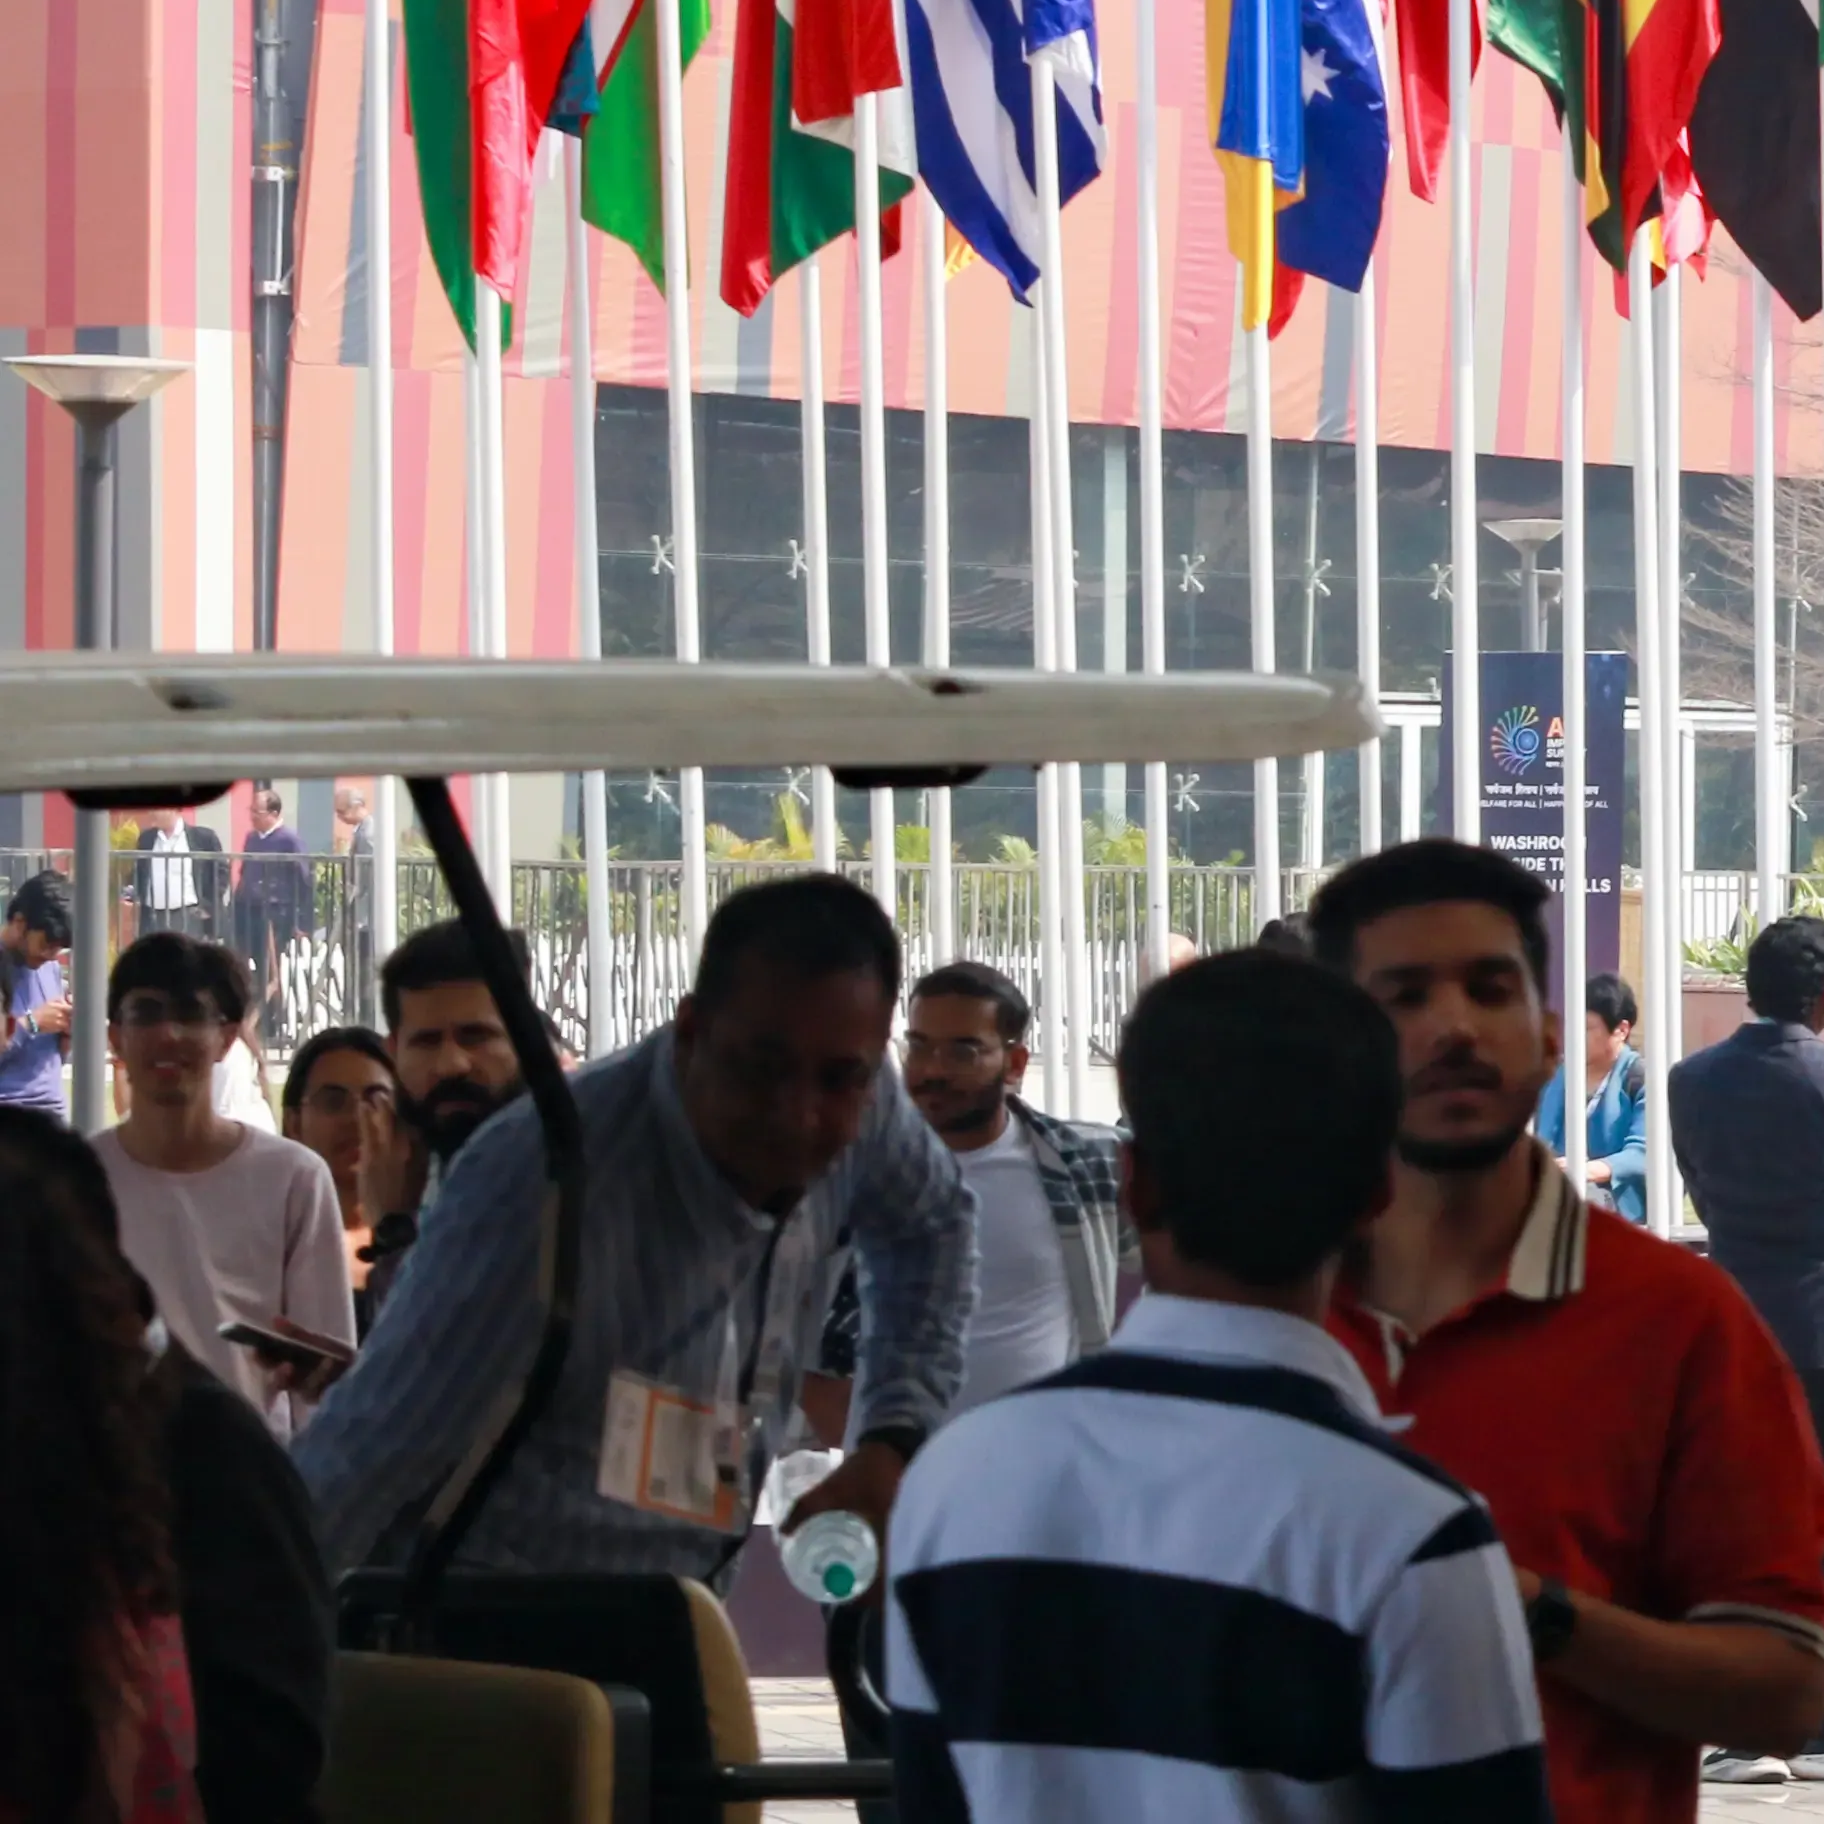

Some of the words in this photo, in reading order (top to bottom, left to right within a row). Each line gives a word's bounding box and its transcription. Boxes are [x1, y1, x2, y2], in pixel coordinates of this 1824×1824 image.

[1546, 716, 1564, 738] A
[1480, 799, 1507, 808] ELFARE
[1490, 835, 1587, 850] WASHRO
